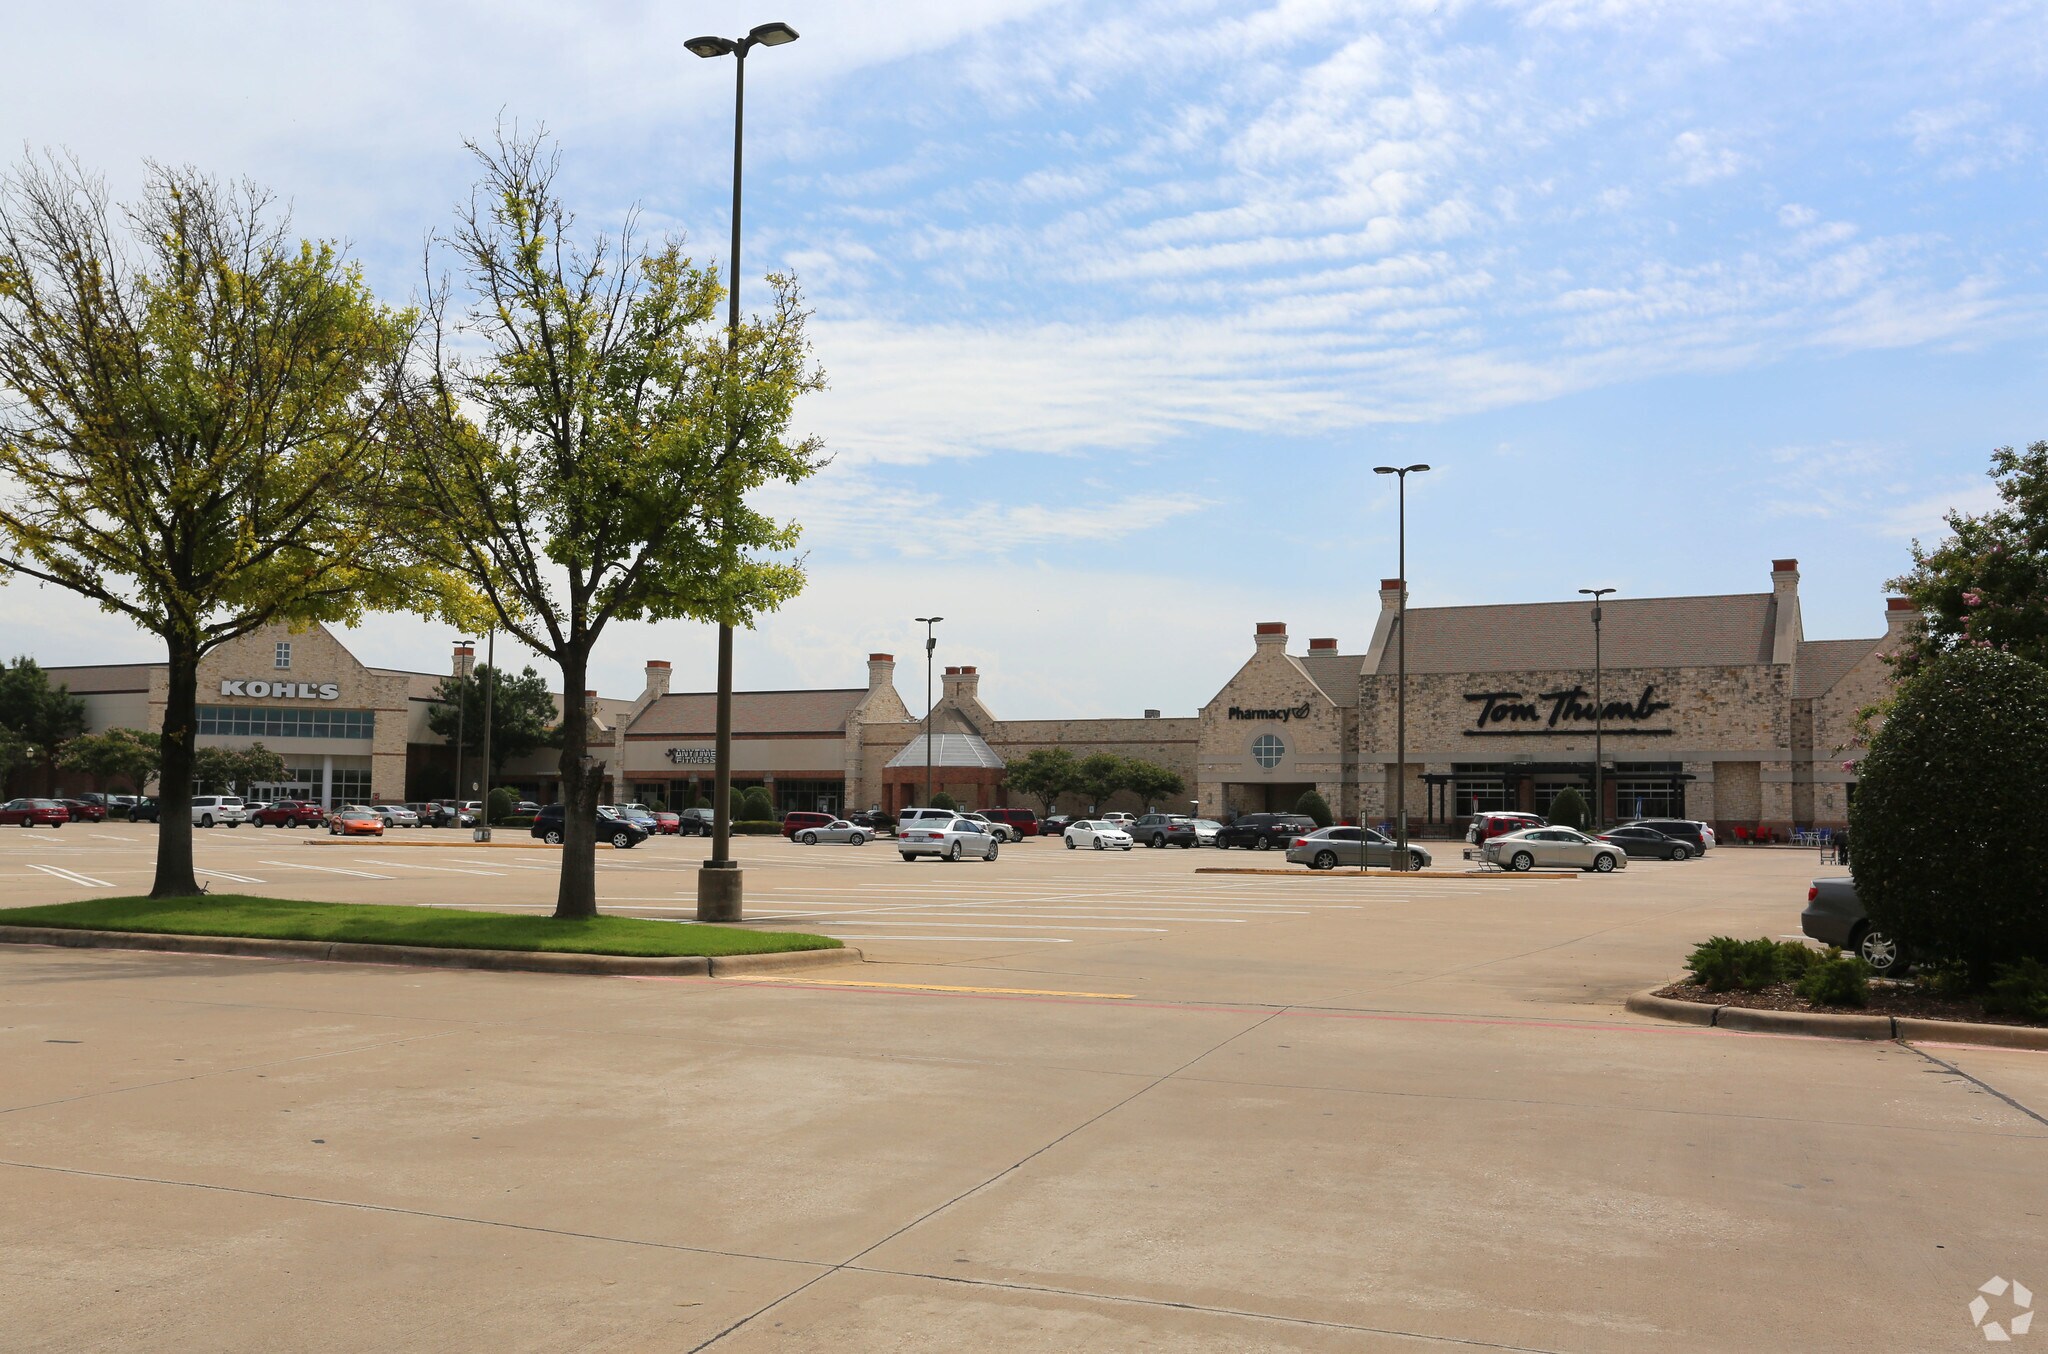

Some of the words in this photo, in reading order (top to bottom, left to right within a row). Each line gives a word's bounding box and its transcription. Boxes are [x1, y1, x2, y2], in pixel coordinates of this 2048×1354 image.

[221, 680, 340, 701] KOHL'S
[1228, 706, 1291, 723] Pharmacy
[1463, 692, 1539, 728] Tom
[1538, 685, 1670, 728] Thumb
[675, 748, 716, 757] ANYTIME
[676, 756, 716, 764] FITNESS
